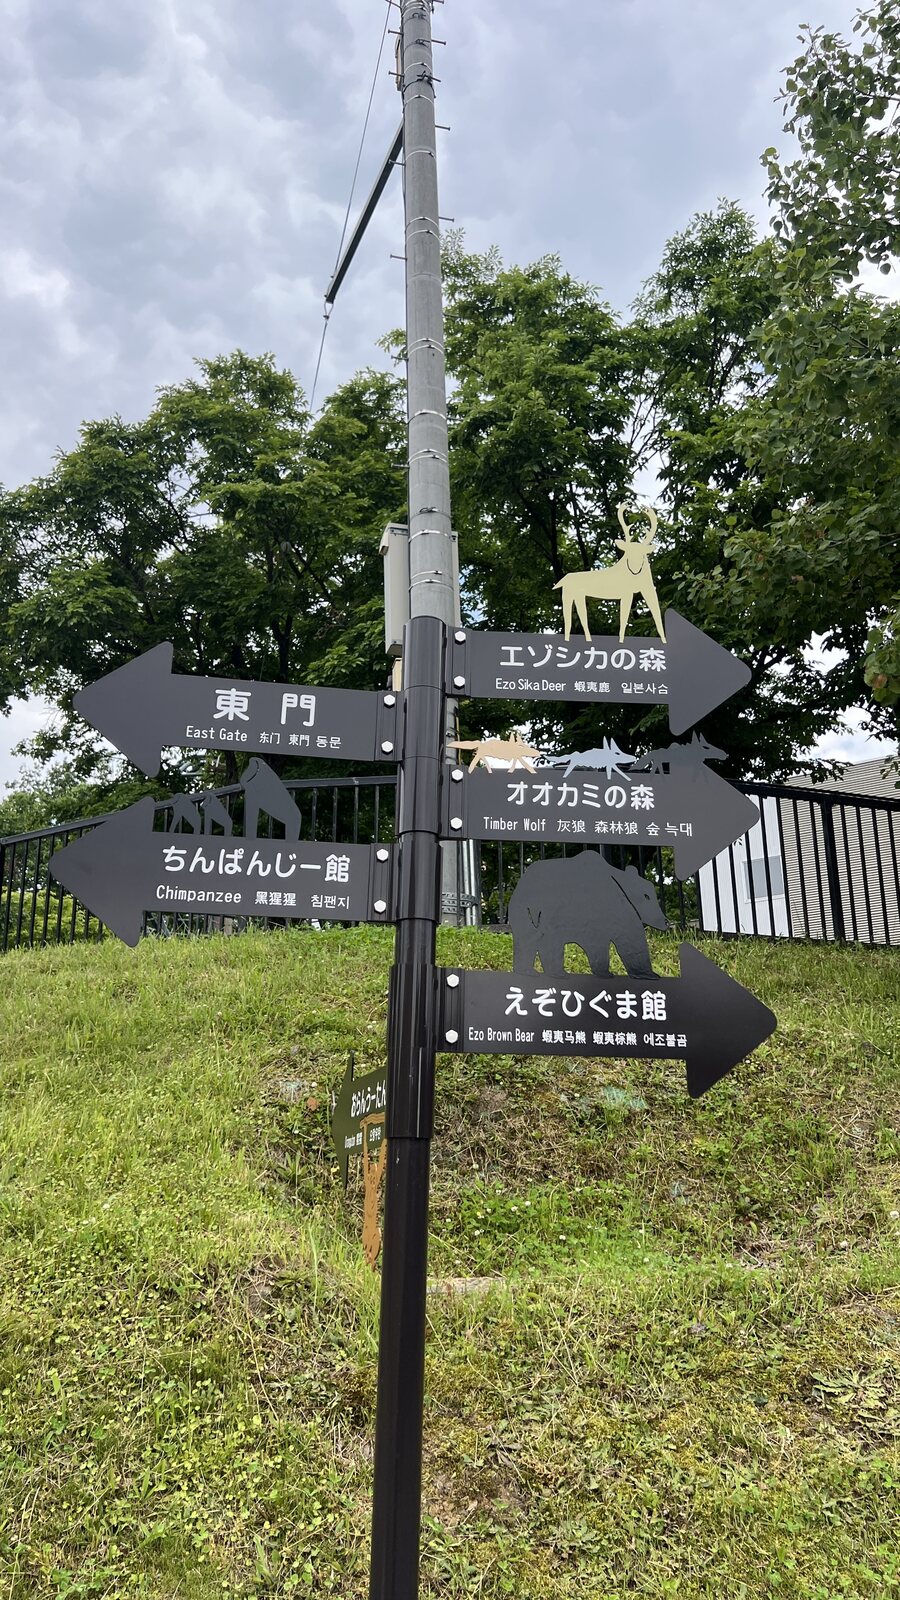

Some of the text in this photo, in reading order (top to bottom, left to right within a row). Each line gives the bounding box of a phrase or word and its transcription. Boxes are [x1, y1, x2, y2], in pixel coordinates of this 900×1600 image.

[499, 645, 667, 673] エゾシカの森
[495, 677, 567, 692] Ezo Sika Deer
[573, 681, 611, 693] 蝦夷鹿
[620, 682, 669, 695] 일본사슴
[185, 725, 248, 742] East Gate
[258, 731, 281, 745] 东门
[288, 733, 310, 747] 東門
[315, 735, 342, 750] 동문
[507, 781, 656, 811] オオカミの森
[482, 816, 547, 832] Timber Wolf
[556, 818, 587, 834] 灰狼
[594, 820, 639, 836] 森林狼
[645, 821, 694, 838] 숲 늑대
[162, 845, 351, 883] ちんぱんじー館
[156, 884, 242, 904] Chimpanzee
[254, 890, 297, 907] 黑猩猩
[310, 893, 350, 910] 침팬지
[504, 986, 668, 1021] えぞひぐま館
[468, 1026, 535, 1043] Ezo Brown Bear
[643, 1032, 688, 1048] 에조불곰
